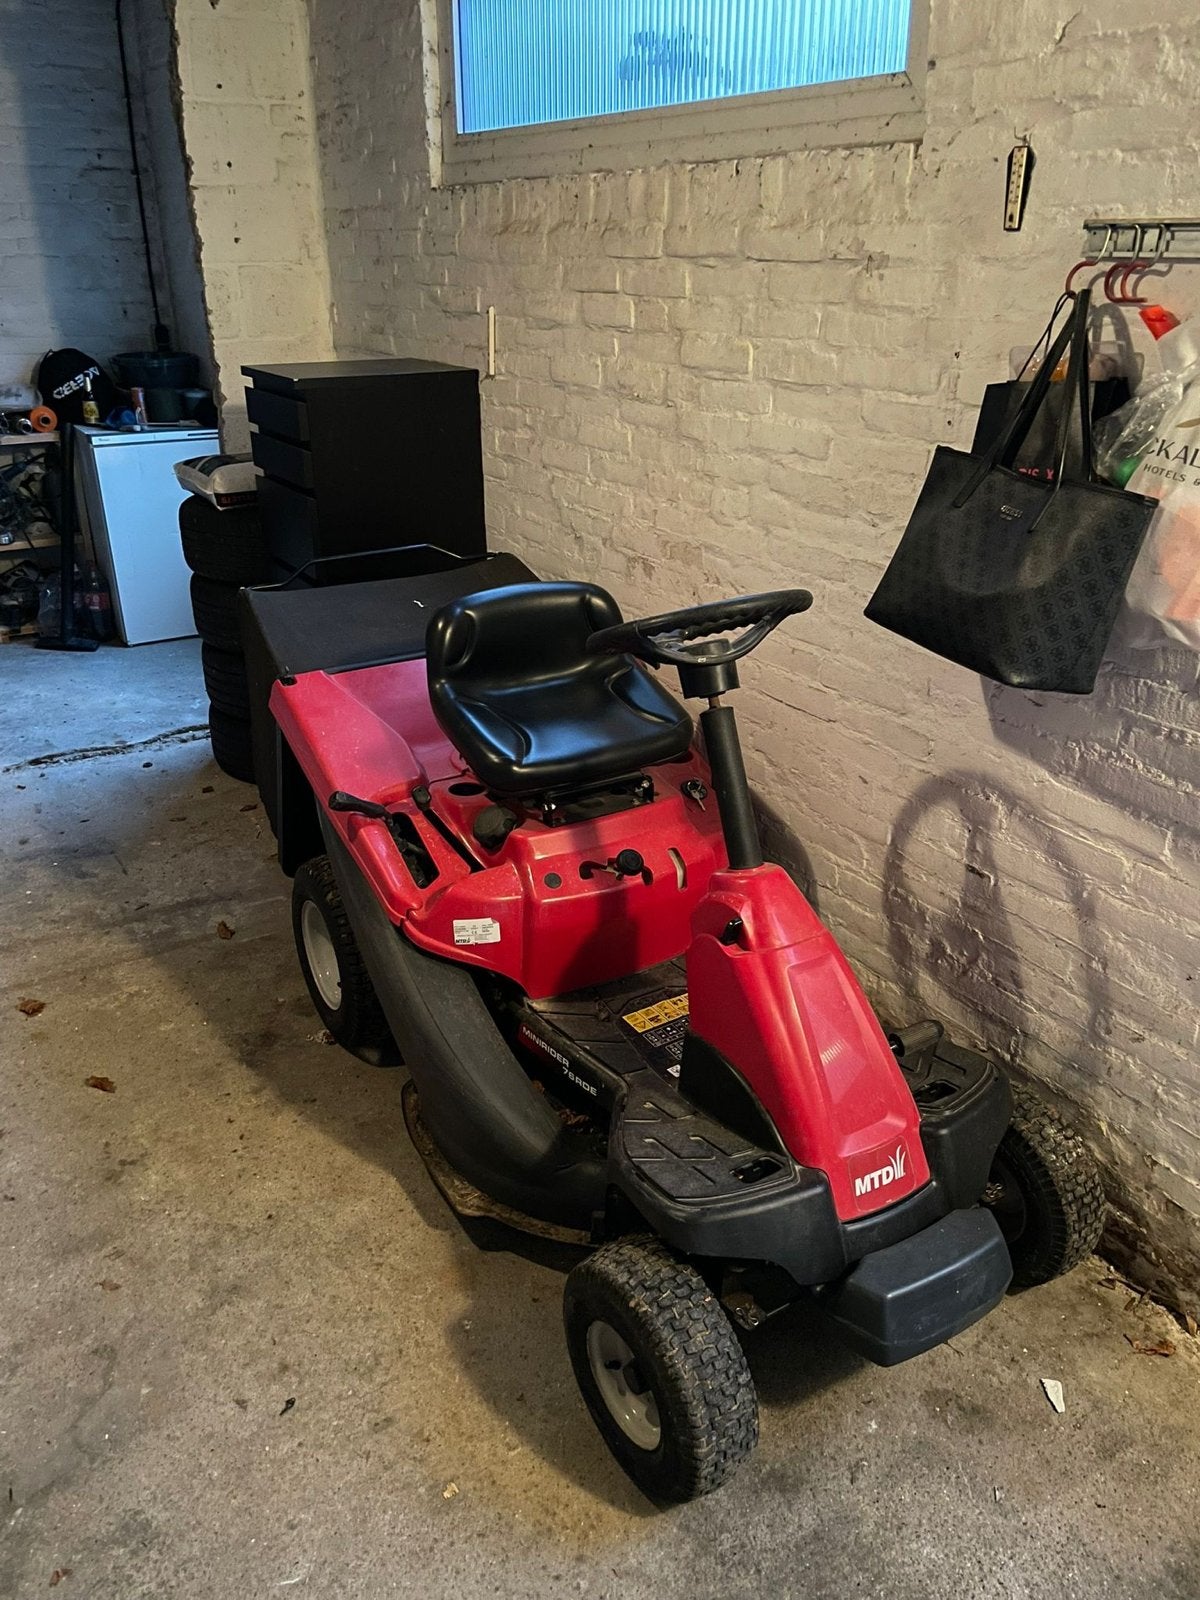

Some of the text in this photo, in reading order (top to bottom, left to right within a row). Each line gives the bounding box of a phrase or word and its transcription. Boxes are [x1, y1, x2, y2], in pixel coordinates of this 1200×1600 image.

[1143, 463, 1187, 482] HOTELS
[522, 1026, 570, 1068] MINIRIDER
[855, 1166, 894, 1197] MTD
